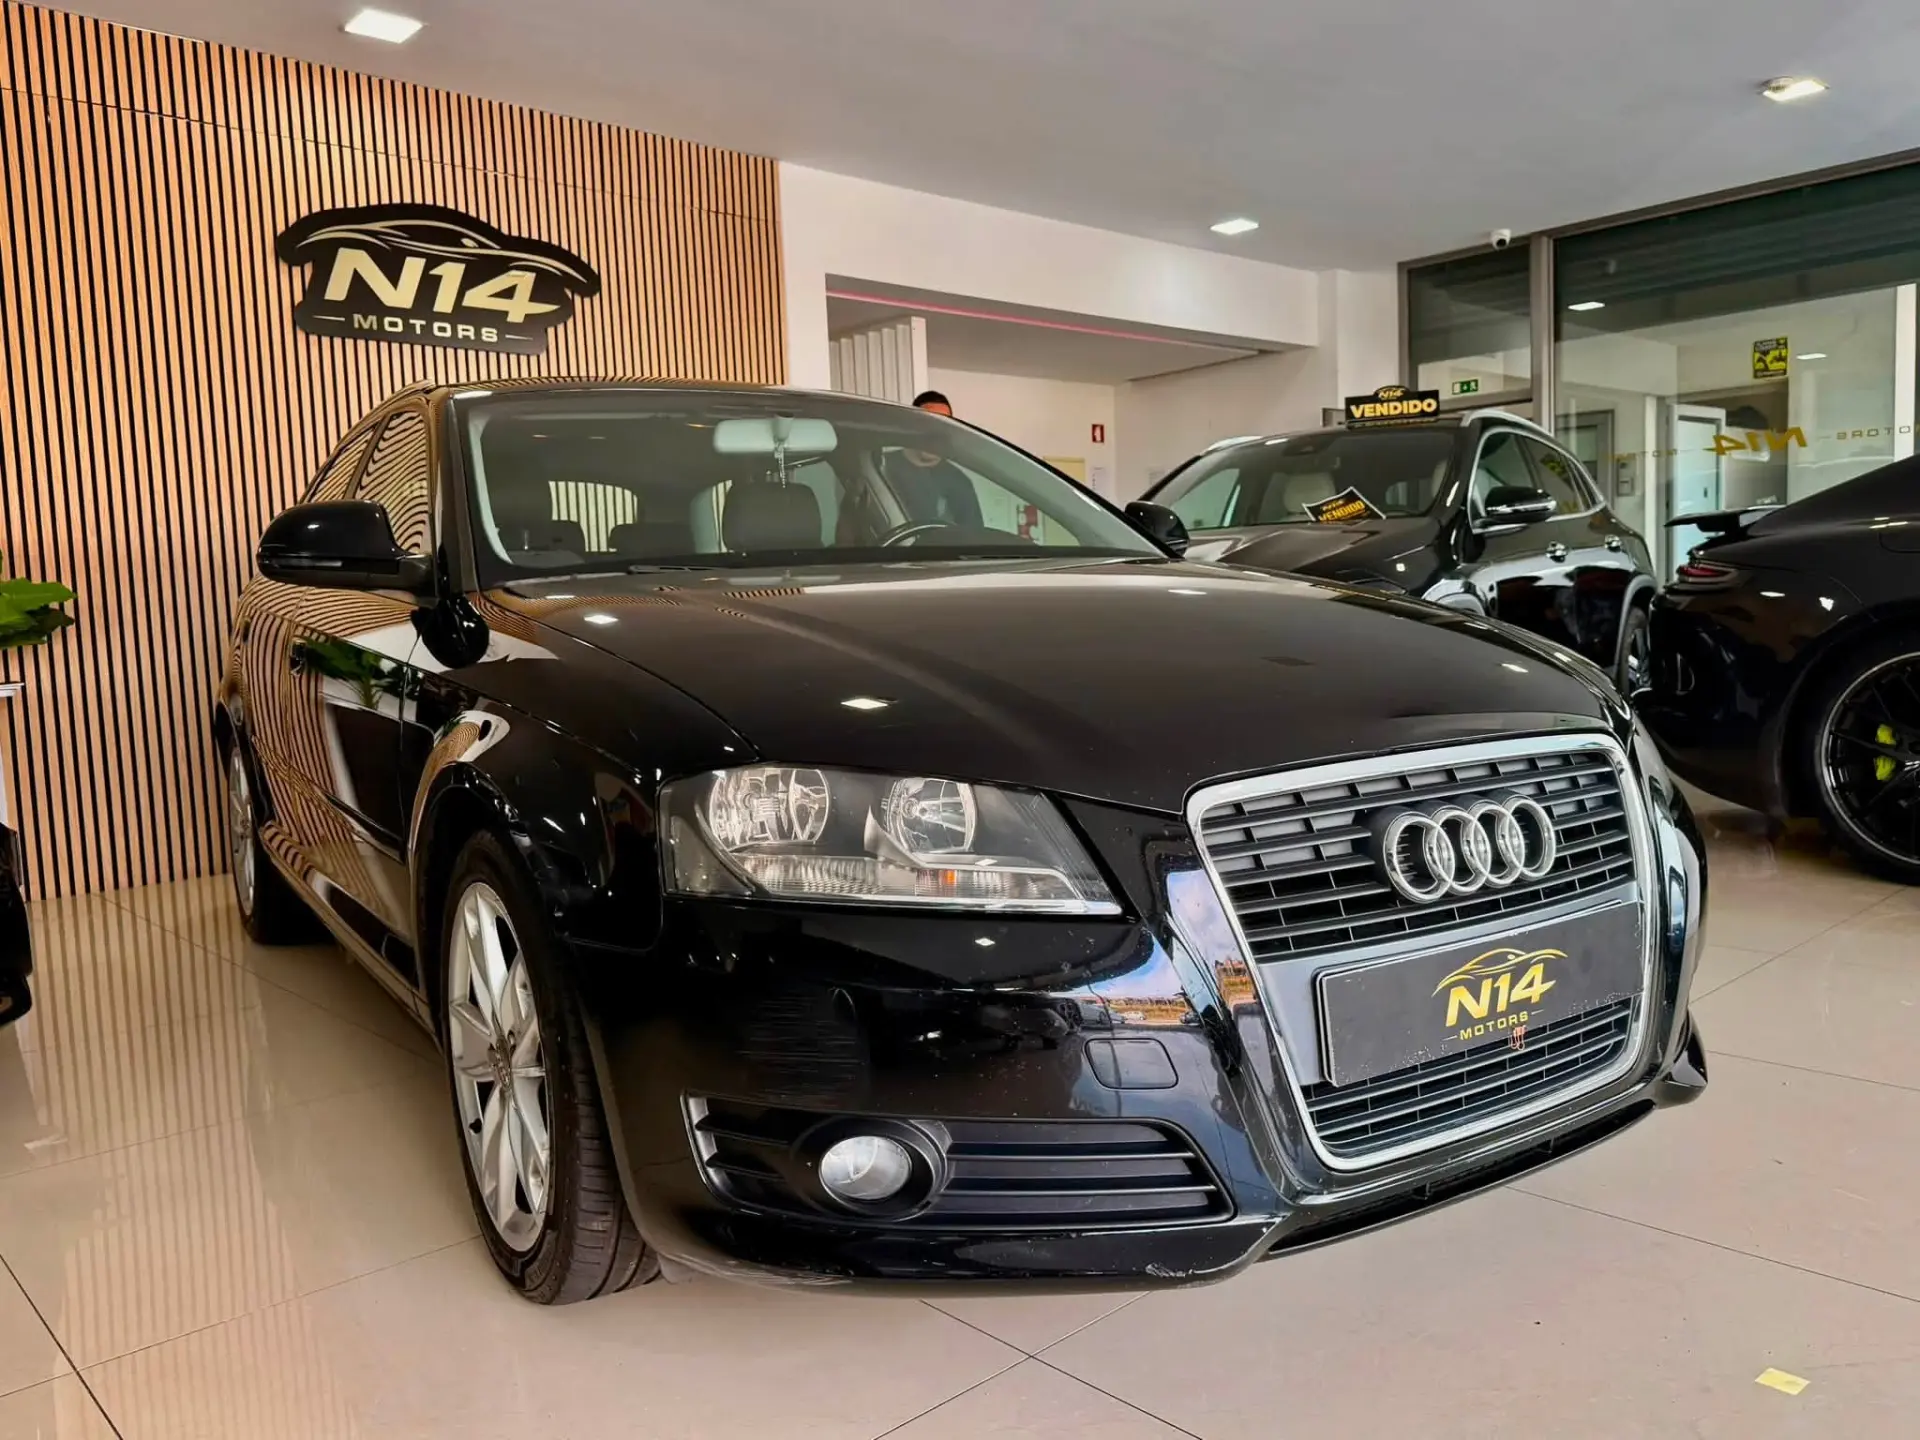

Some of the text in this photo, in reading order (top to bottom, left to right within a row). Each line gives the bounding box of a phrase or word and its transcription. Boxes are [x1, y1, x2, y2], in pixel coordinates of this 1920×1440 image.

[324, 247, 561, 323] N14
[353, 313, 498, 342] MOTORS
[1350, 398, 1437, 419] VENDIDO
[1446, 963, 1556, 1027] N14
[1460, 1011, 1529, 1040] MOTORS
